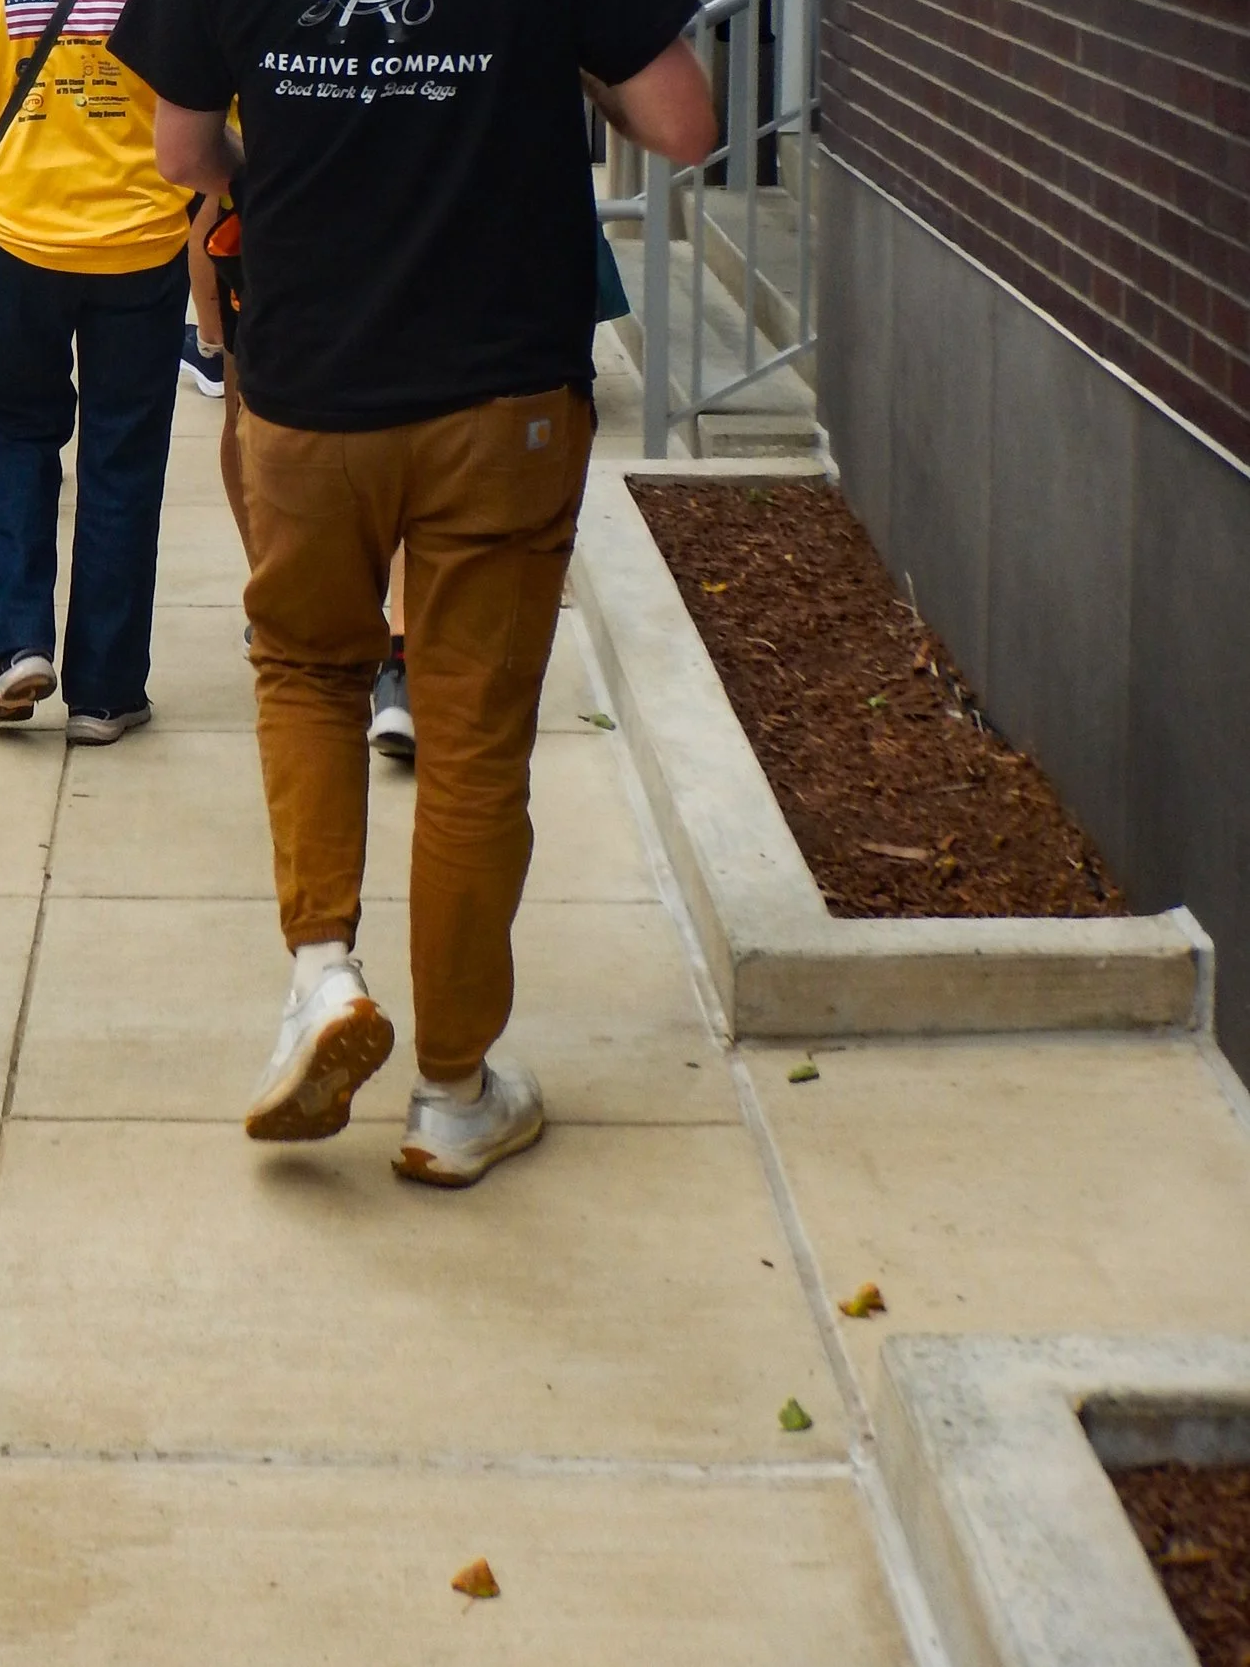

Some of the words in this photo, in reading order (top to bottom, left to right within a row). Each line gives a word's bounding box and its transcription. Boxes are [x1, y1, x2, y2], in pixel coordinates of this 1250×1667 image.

[259, 52, 358, 76] REATIVE
[370, 53, 493, 76] COMPANY
[275, 79, 313, 97] Good
[316, 82, 356, 99] Work
[360, 84, 377, 104] by
[380, 80, 415, 98] Bad
[420, 80, 457, 100] Eggs
